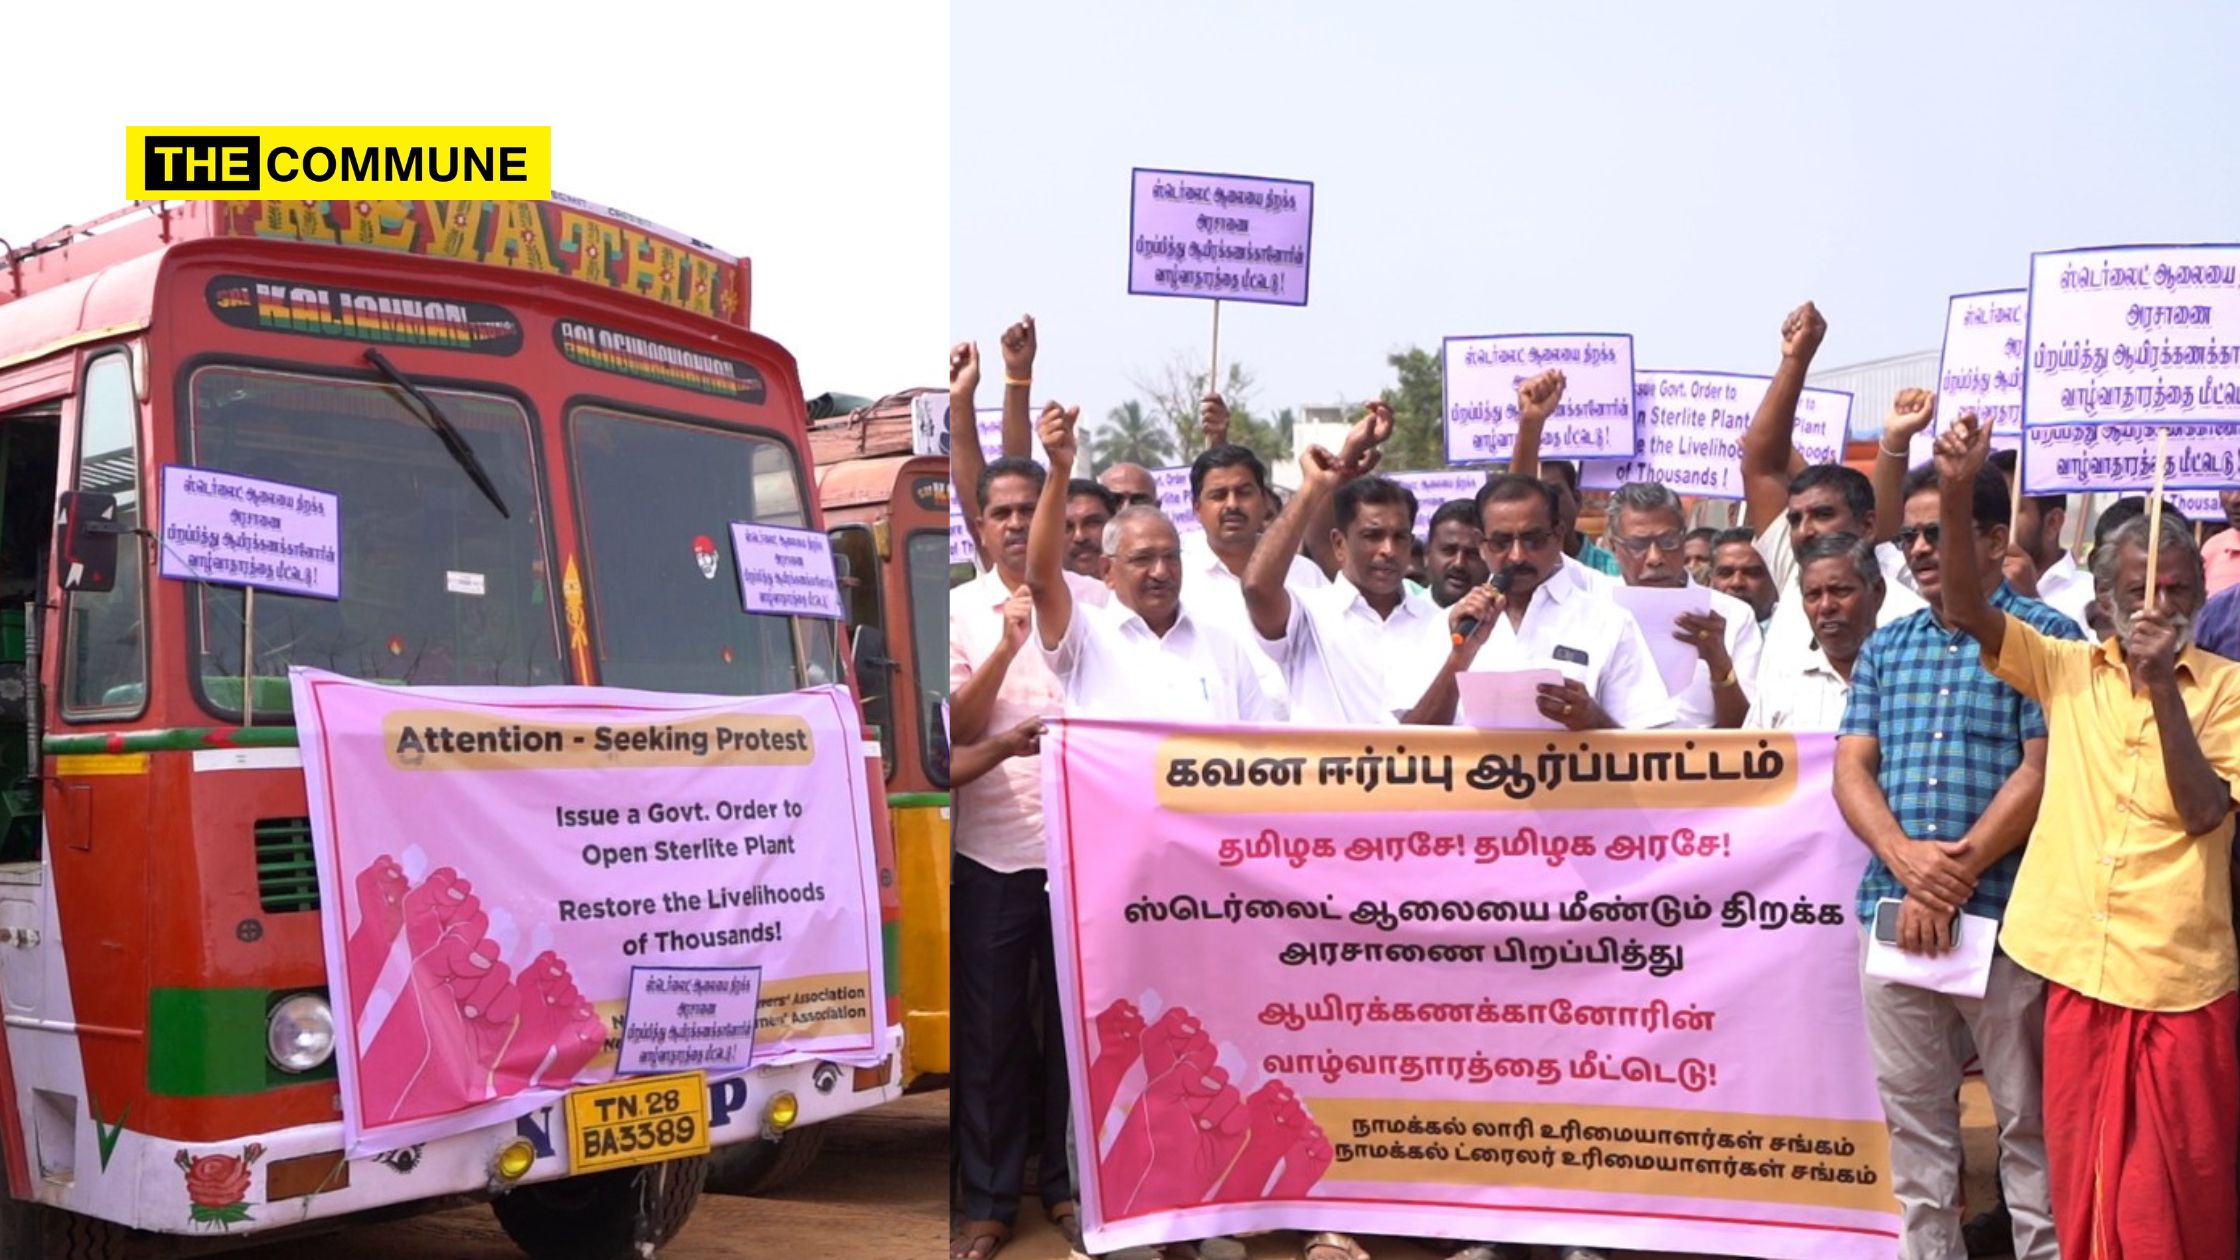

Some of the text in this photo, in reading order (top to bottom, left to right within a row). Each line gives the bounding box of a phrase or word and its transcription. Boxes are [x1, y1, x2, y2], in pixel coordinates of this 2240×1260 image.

[1691, 381, 1722, 398] Order
[1725, 384, 1737, 400] to
[1650, 405, 1706, 428] Sterlite
[1711, 408, 1751, 430] Plant
[1650, 436, 1674, 454] the
[1679, 436, 1745, 459] Livelihoo
[1616, 464, 1632, 482] of
[1637, 462, 1718, 487] Thousands
[396, 726, 563, 756] Attention
[593, 725, 709, 757] Seeking
[716, 726, 809, 754] Protest
[1166, 739, 1784, 800] கவன ஈர்ப்பு ஆர்ப்பாட்டம்
[556, 798, 803, 828] Issue a Govt. Order to
[582, 835, 796, 869] Open Sterlite Plant
[1219, 827, 1731, 869] தமிழக அரசே! தமிழக அரசே!
[558, 882, 826, 922] Restore the Livelihoods
[1124, 891, 1844, 932] ஸ்டெர்லைட் ஆலையை மீண்டும் திறக்க
[623, 921, 783, 956] of Thousands!
[1279, 937, 1685, 978] அரசாணை பிறப்பித்து
[793, 987, 866, 1005] Association
[1258, 992, 1717, 1034] ஆயிரக்கணக்கானோரின்
[792, 1007, 866, 1024] Association
[1262, 1048, 1718, 1092] வாழ்வாதாரத்தை மீட்டெடு!
[1352, 1115, 1856, 1157] நாமக்கல் லாரி உரிமையாளர்கள் சங்கம்
[1335, 1141, 1448, 1163] நாமக்கல்
[1562, 1147, 1786, 1179] உரிமையாளர்கள்
[1791, 1162, 1878, 1186] சங்கம்
